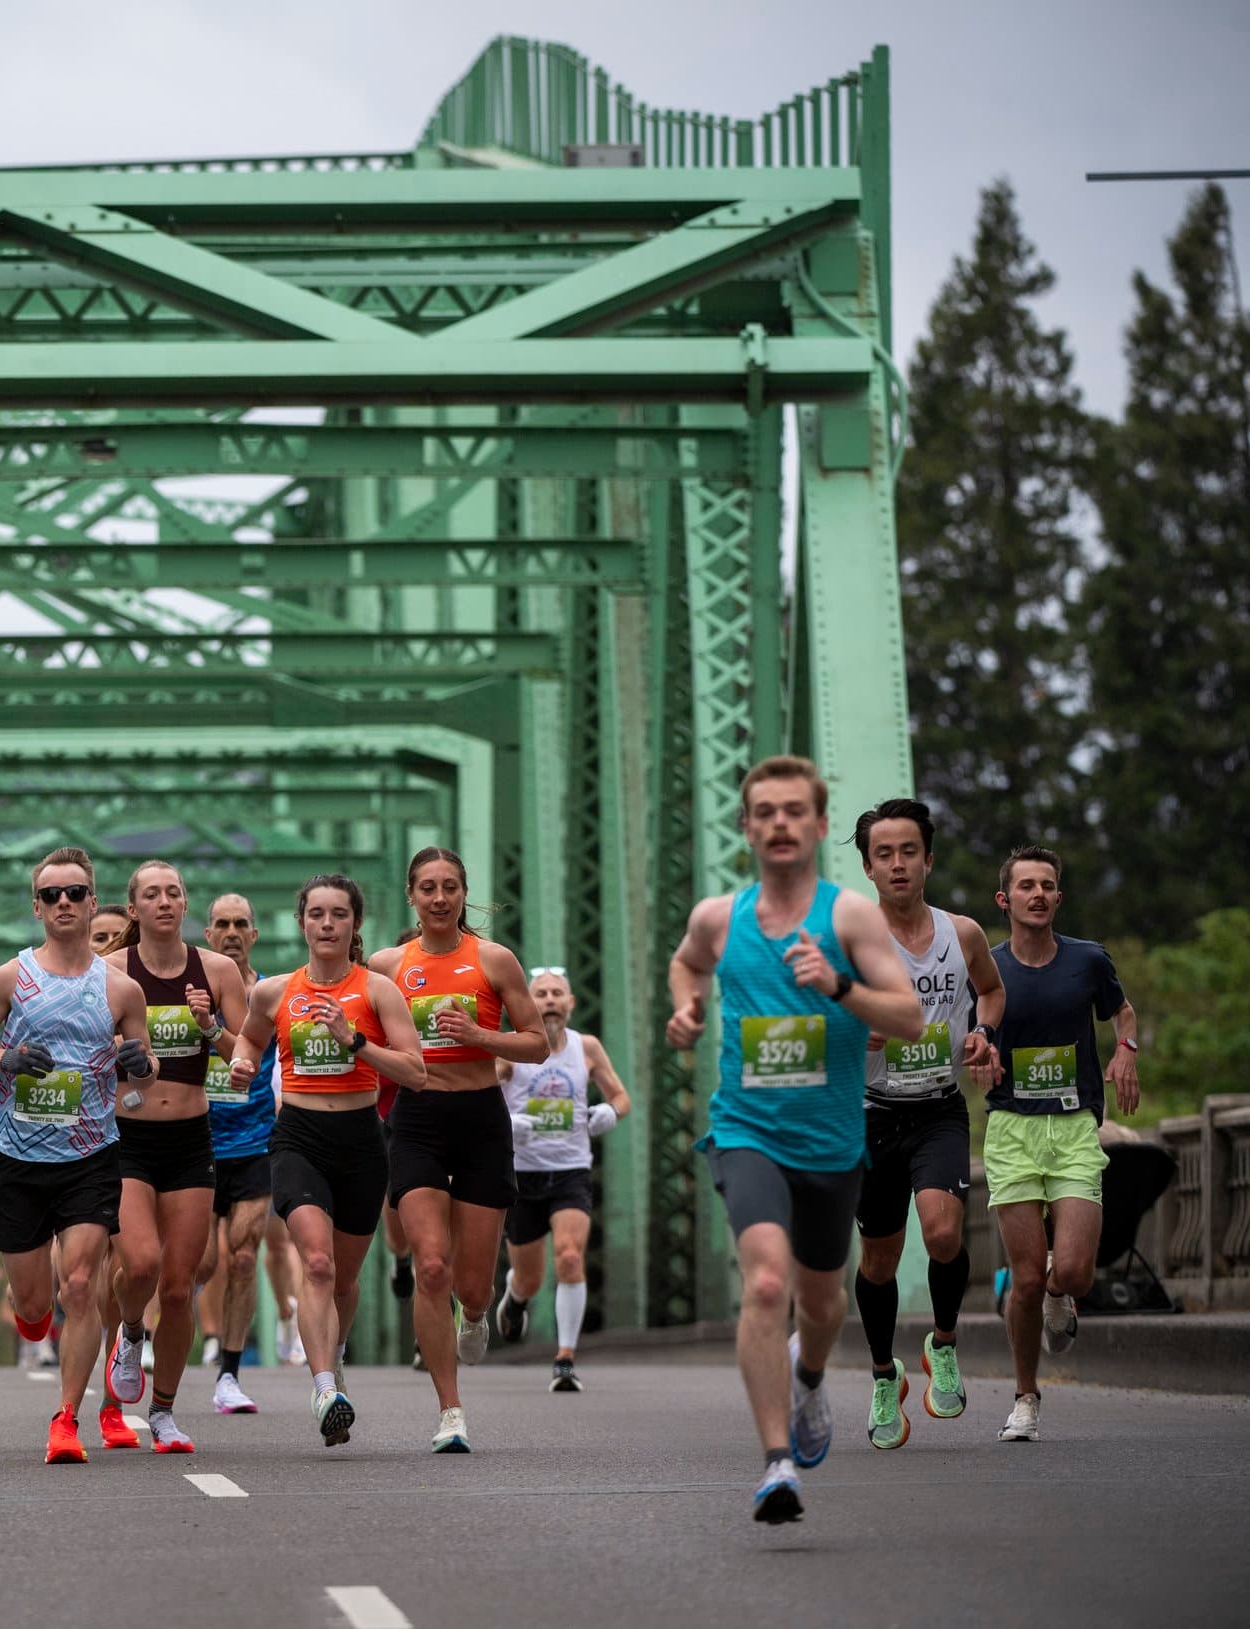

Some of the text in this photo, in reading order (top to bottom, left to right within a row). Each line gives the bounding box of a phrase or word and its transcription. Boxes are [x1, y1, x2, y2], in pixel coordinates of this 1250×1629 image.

[918, 994, 954, 1007] ING LAB
[153, 1023, 188, 1040] 3019
[305, 1039, 340, 1057] 3013
[757, 1040, 807, 1064] 3529
[901, 1042, 937, 1063] 3510
[207, 1071, 230, 1087] 432
[1028, 1064, 1063, 1082] 3413
[28, 1087, 66, 1106] 3234
